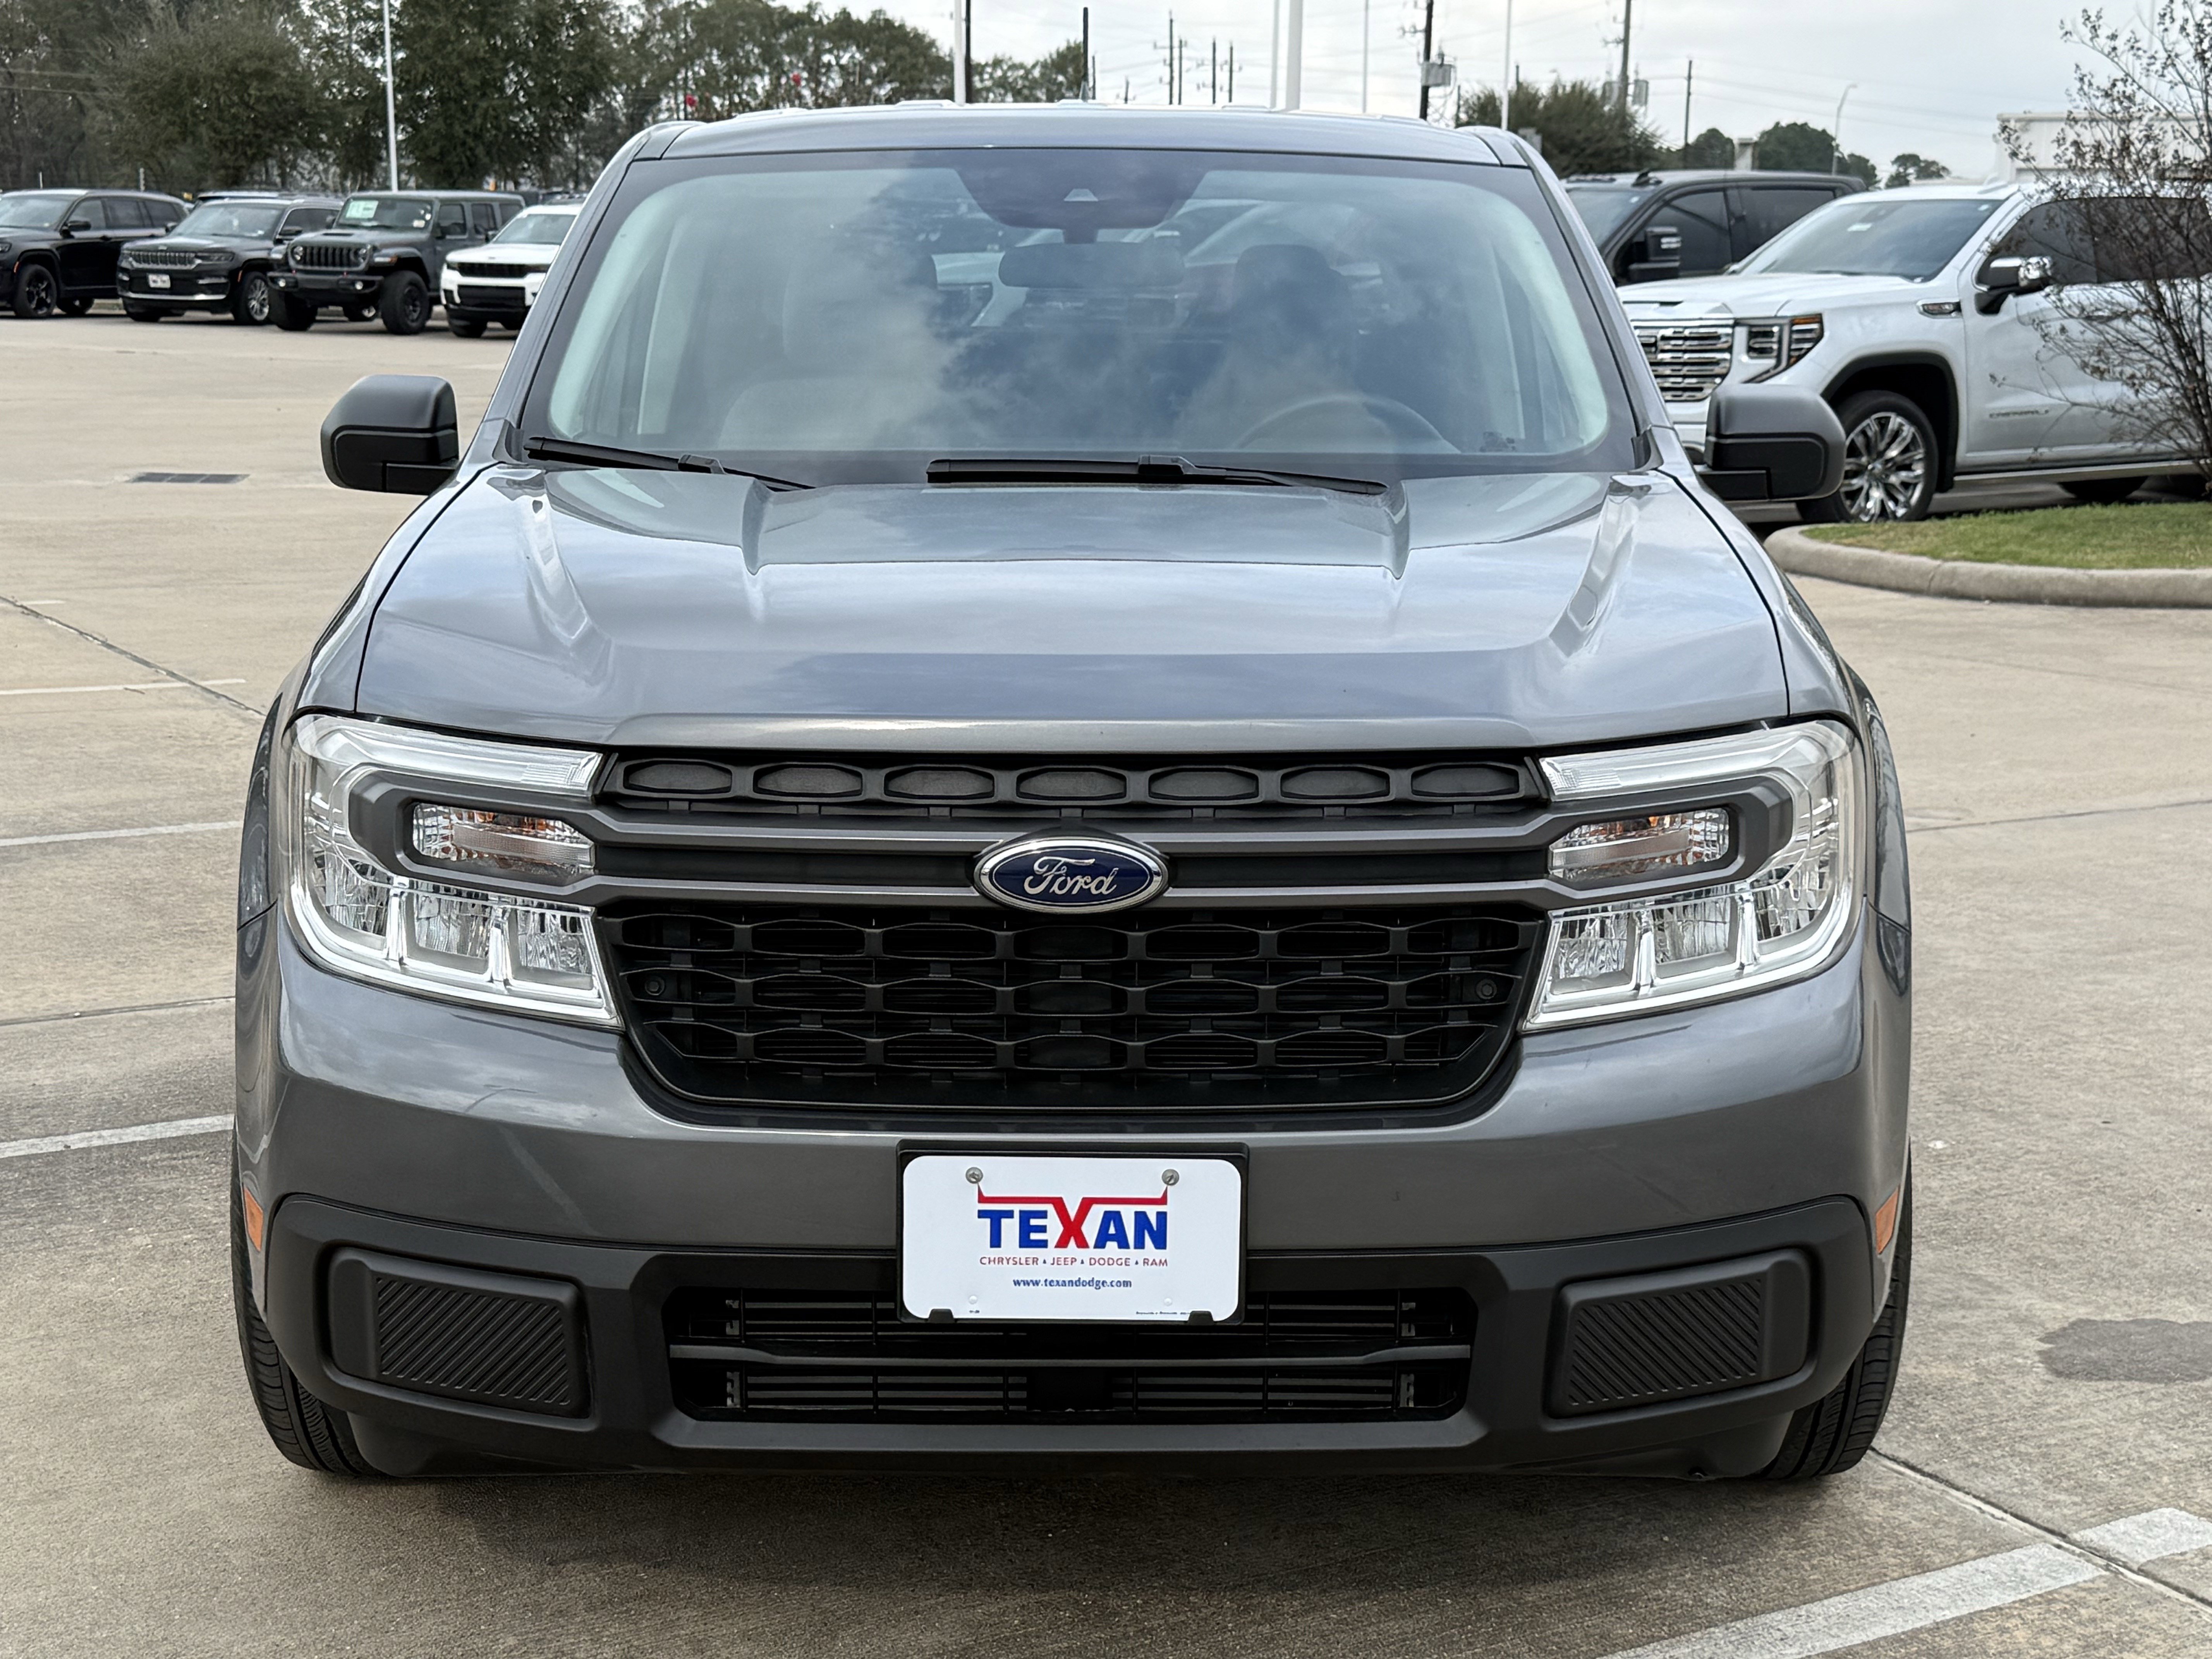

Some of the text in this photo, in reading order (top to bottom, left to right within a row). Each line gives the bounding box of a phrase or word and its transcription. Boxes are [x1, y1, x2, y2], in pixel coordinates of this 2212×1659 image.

[1024, 856, 1119, 895] Ford
[977, 1197, 1167, 1249] TEXAN
[979, 1256, 1168, 1267] CHRYSLER JEEP DODGE RAM
[1013, 1277, 1132, 1290] www.texandodge.com
